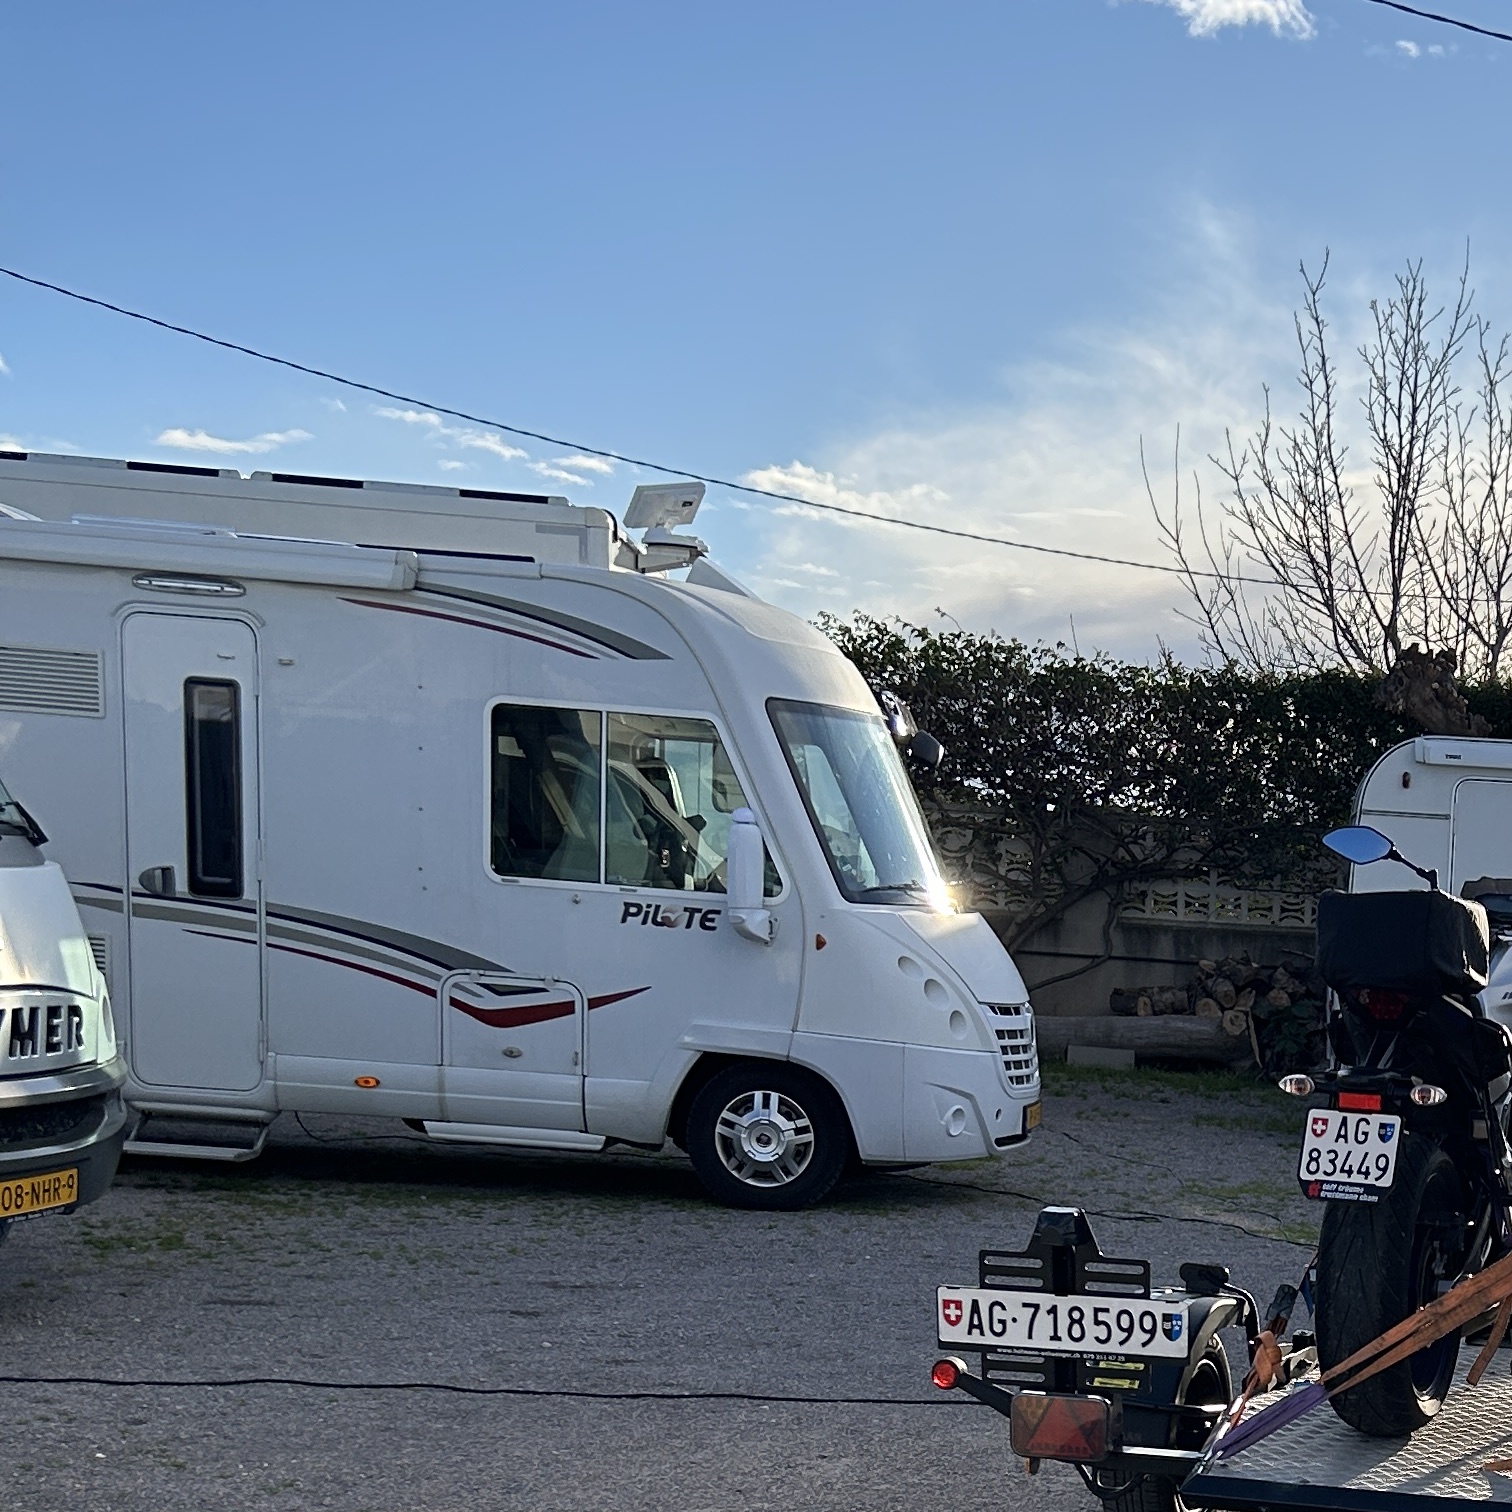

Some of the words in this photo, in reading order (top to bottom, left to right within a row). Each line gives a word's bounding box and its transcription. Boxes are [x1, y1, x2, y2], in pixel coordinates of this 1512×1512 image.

[0, 1004, 85, 1060] MER
[1334, 1115, 1371, 1145] AG
[1306, 1147, 1390, 1181] 83449
[1, 1173, 75, 1212] 08-NHR-9
